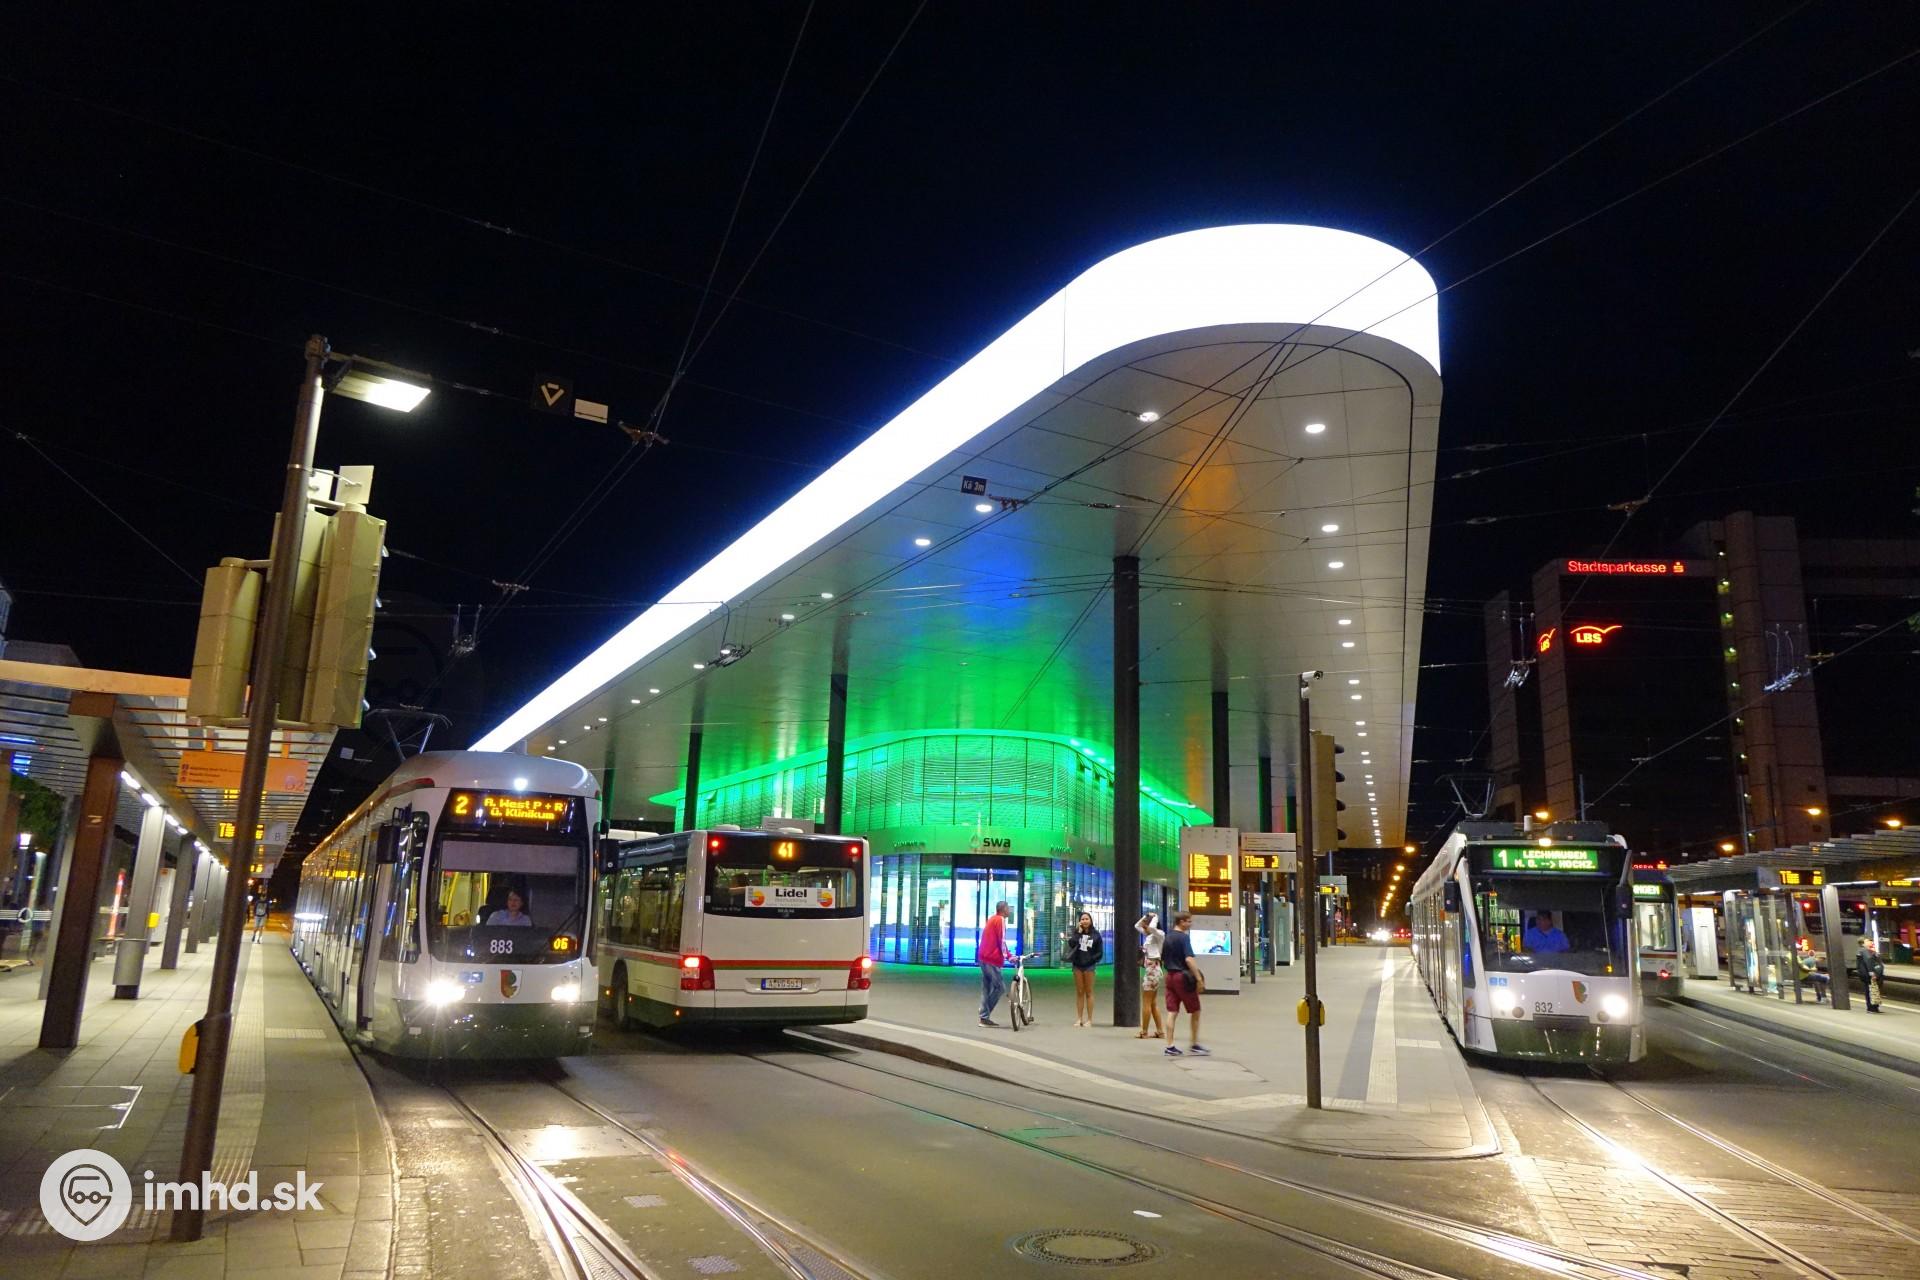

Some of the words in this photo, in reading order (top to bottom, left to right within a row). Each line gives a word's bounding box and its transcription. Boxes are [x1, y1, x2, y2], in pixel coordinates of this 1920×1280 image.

[1568, 560, 1667, 574] Stadtsparkasse
[1576, 632, 1602, 644] LBS
[455, 796, 469, 815] 2
[500, 799, 530, 810] West
[505, 809, 555, 820] Klinikum
[983, 837, 1011, 848] swa
[778, 842, 795, 858] 41
[1498, 849, 1508, 868] 1
[775, 888, 808, 898] Lidel
[490, 939, 513, 954] 883
[1535, 1001, 1554, 1013] 832
